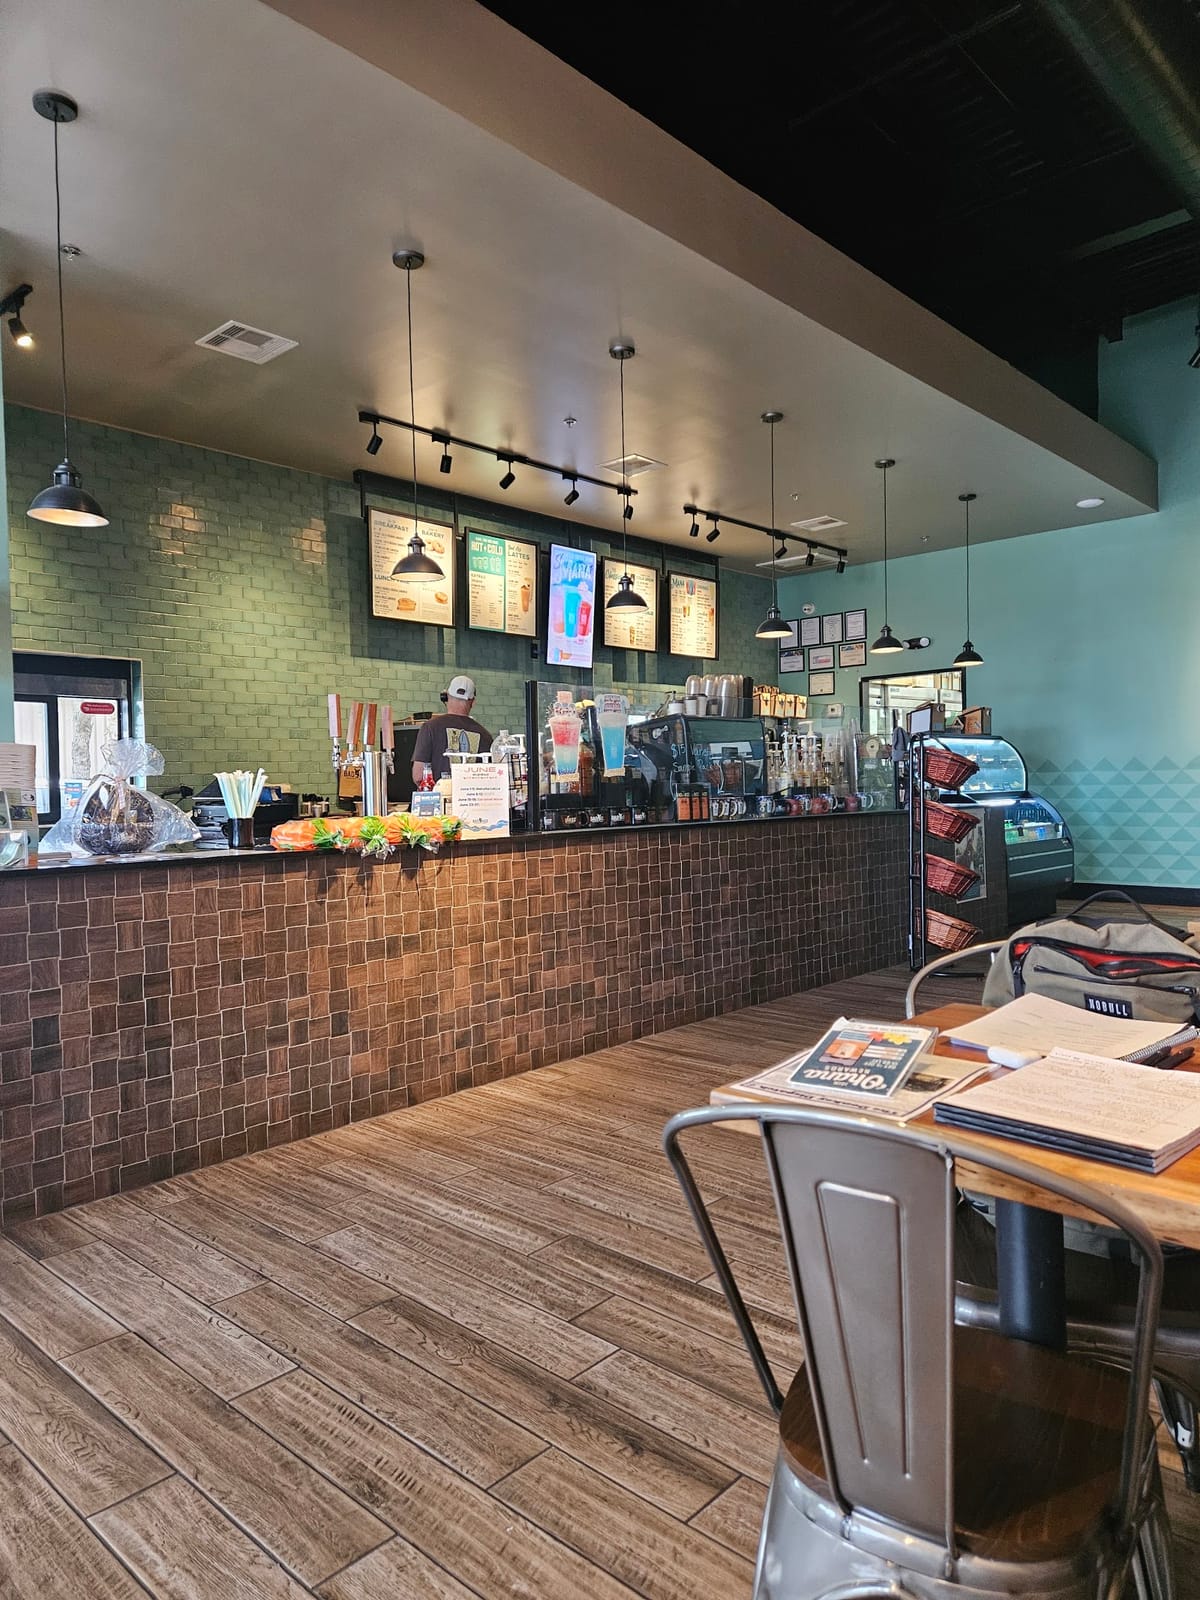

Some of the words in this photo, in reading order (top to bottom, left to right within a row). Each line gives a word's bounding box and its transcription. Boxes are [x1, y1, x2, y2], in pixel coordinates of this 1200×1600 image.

[374, 520, 409, 532] BREAKFAST
[421, 530, 445, 539] BAKERY
[507, 551, 530, 560] LATTES
[1088, 998, 1129, 1016] NOBULL
[823, 1065, 871, 1074] REWARDS
[803, 1069, 887, 1090] Ohana
[759, 1085, 814, 1101] Dispatch
